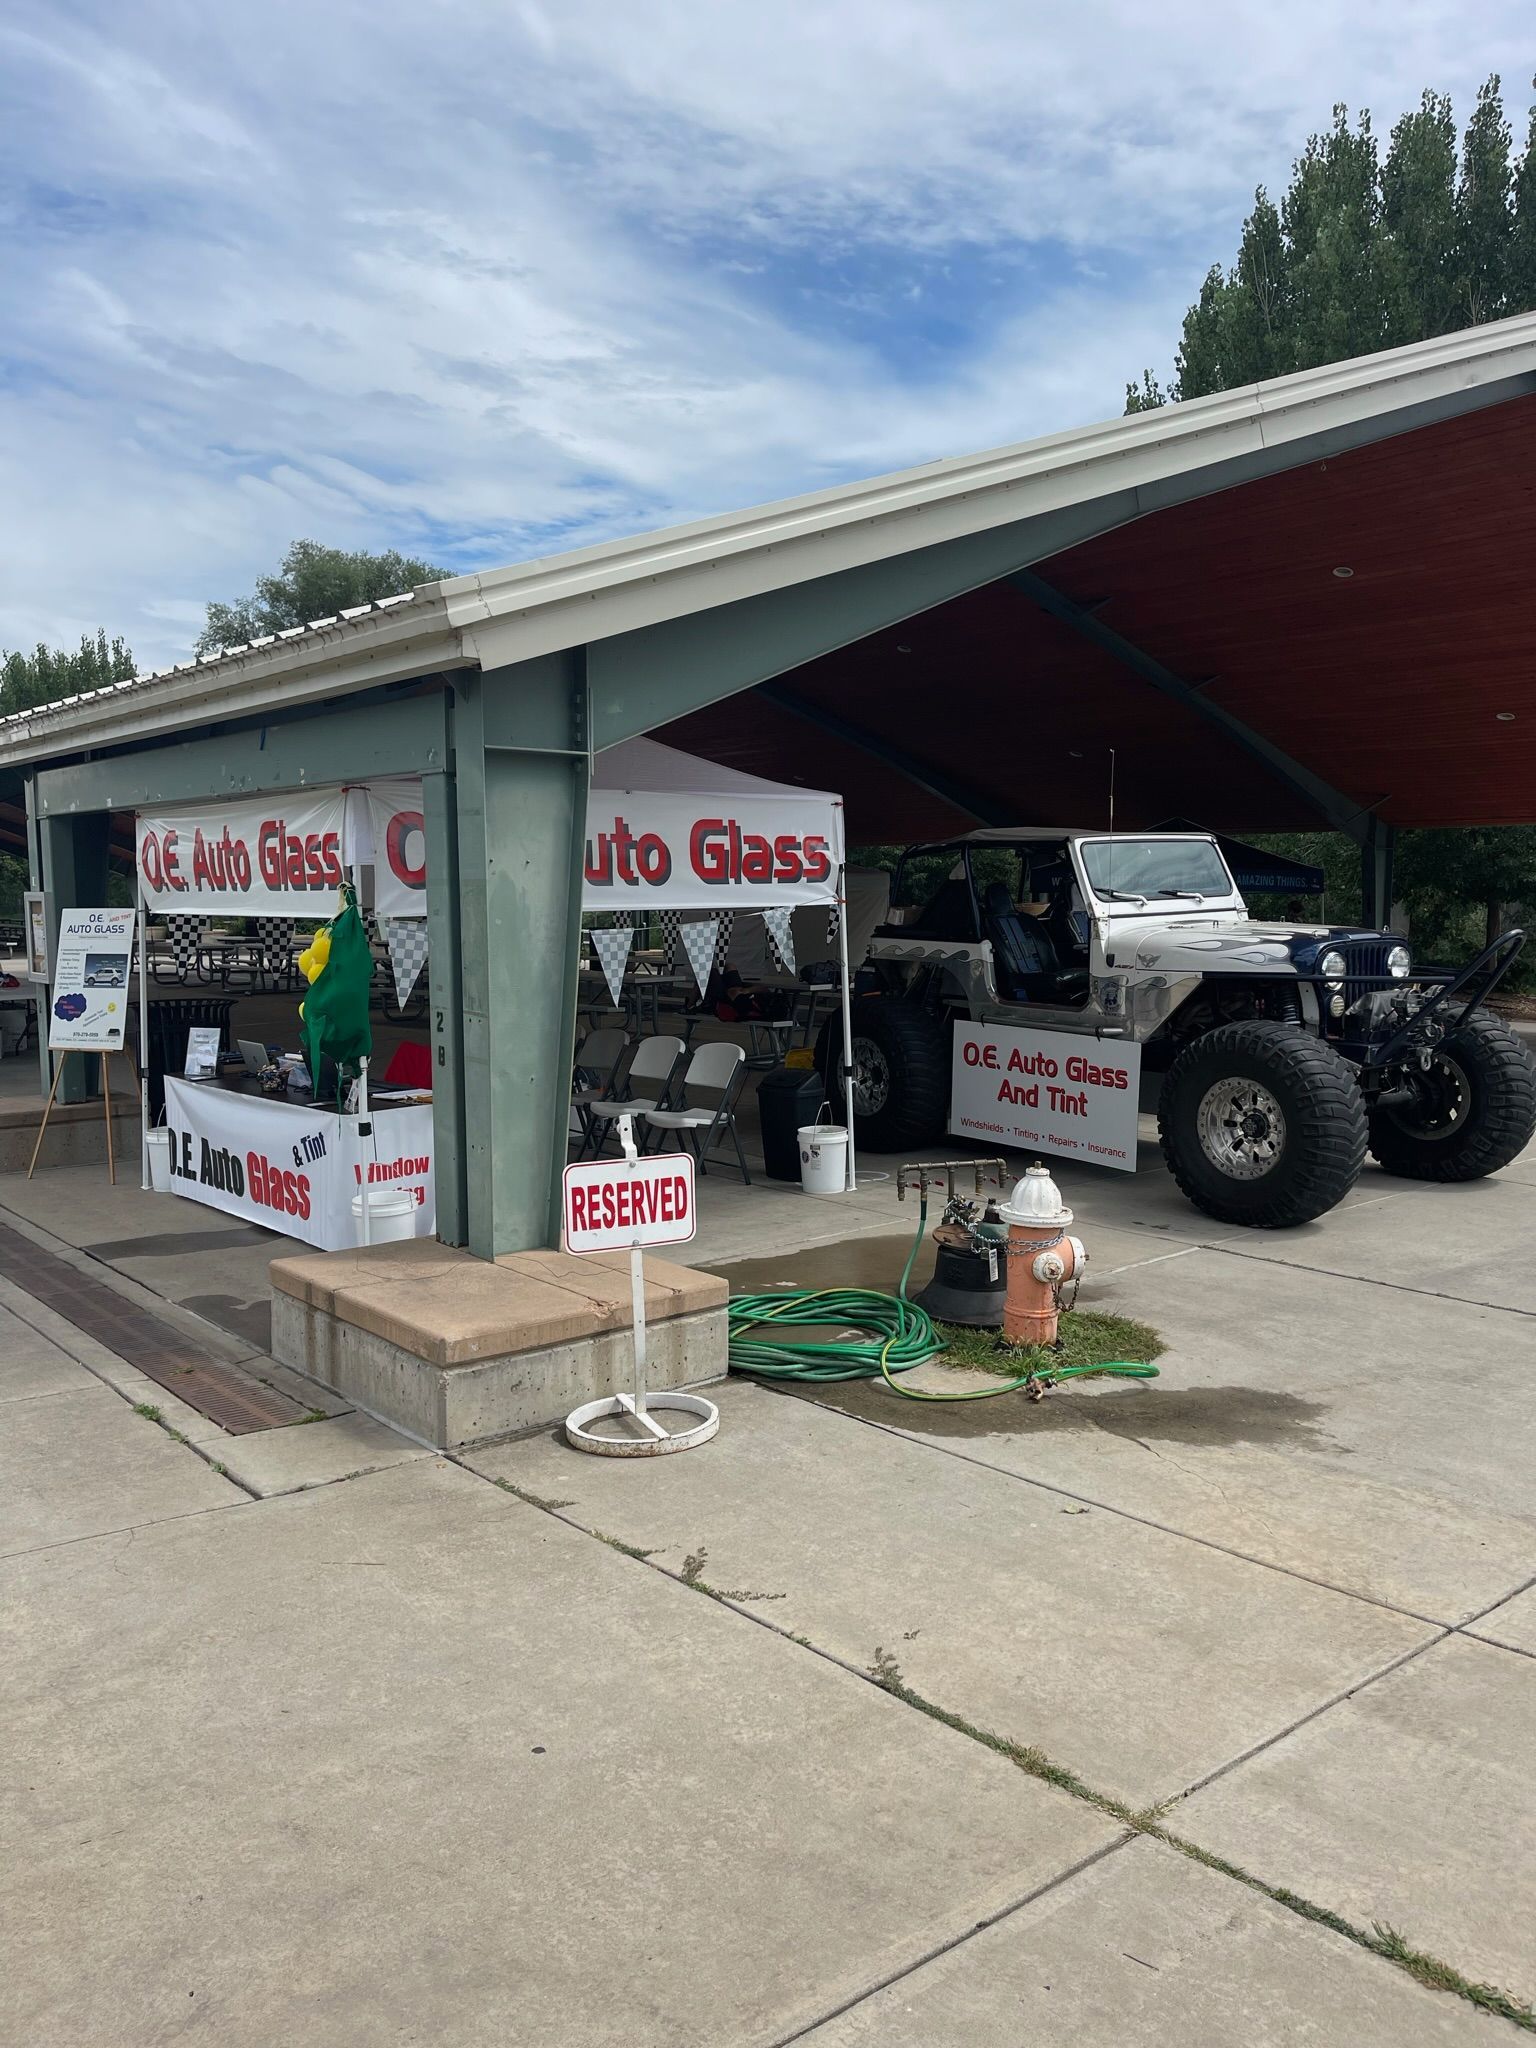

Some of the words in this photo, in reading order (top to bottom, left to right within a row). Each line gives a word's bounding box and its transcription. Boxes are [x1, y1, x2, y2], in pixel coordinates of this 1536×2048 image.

[142, 829, 189, 893] O.E.
[193, 824, 252, 892] Auto
[258, 819, 344, 892] Glass
[584, 816, 672, 887] uto
[689, 818, 832, 885] Glass
[1236, 874, 1275, 887] AMAZING
[1277, 875, 1308, 888] THINGS.
[67, 924, 92, 934] AUTO
[94, 924, 125, 934] GLASS
[88, 913, 105, 923] O.E.
[436, 1011, 445, 1032] 2
[963, 1041, 1001, 1070] O.E.
[1007, 1048, 1059, 1078] Auto
[1065, 1056, 1128, 1090] Glass
[997, 1078, 1039, 1108] And
[1046, 1085, 1088, 1117] Tint
[292, 1145, 304, 1168] &
[300, 1131, 327, 1163] Tint
[960, 1117, 1004, 1133] Windshields
[1013, 1127, 1039, 1142] Tinting
[1049, 1134, 1078, 1149] Repairs
[1087, 1141, 1127, 1159] Insurance
[200, 1137, 245, 1198] Auto
[246, 1151, 311, 1221] Glass
[571, 1175, 688, 1232] RESERVED
